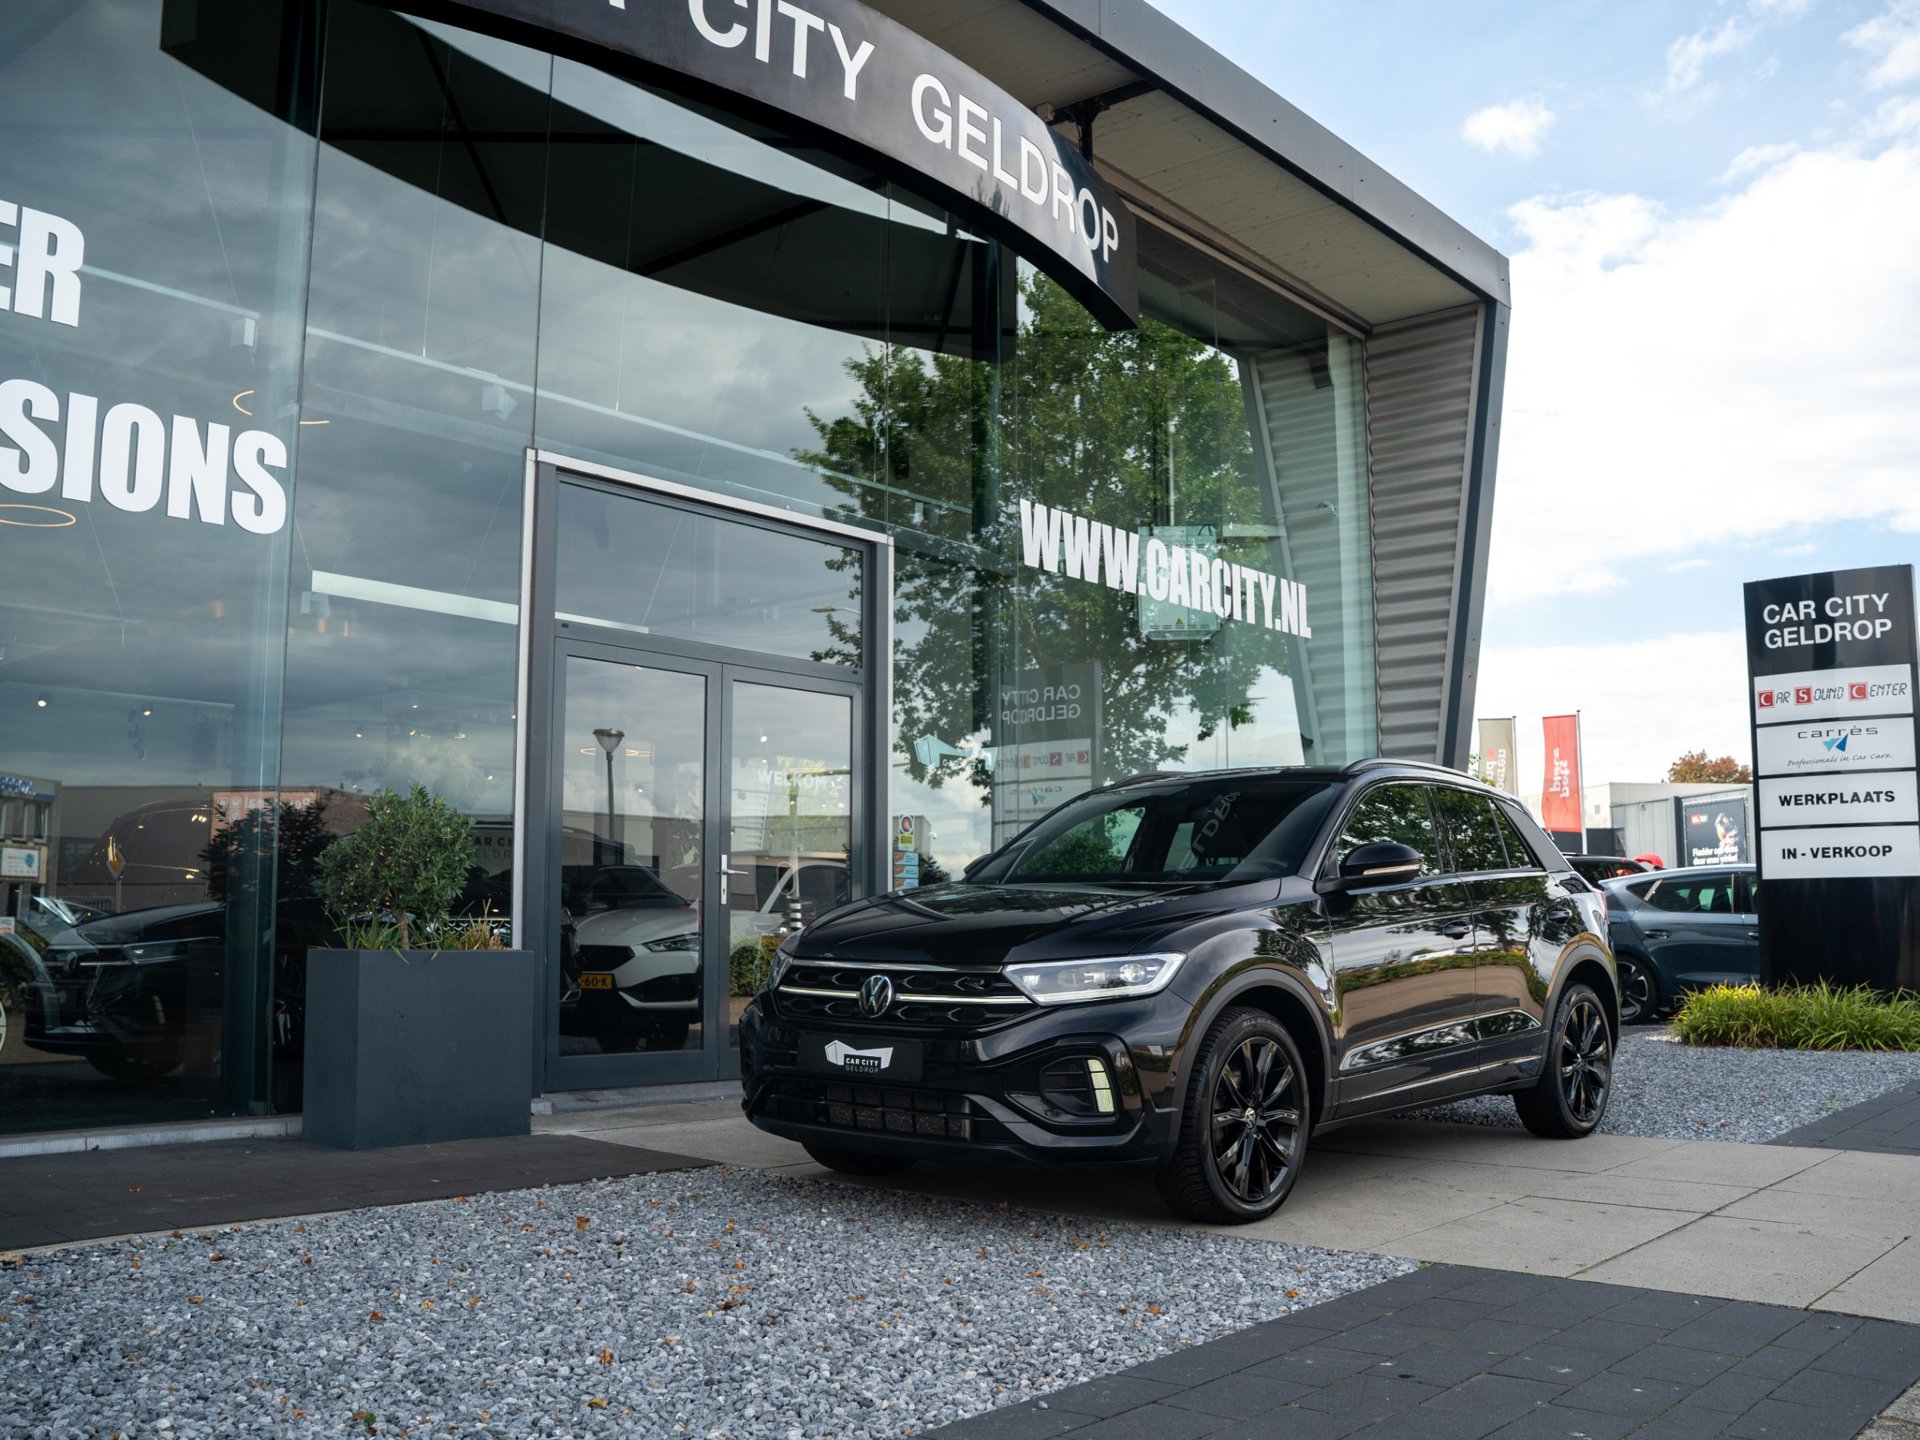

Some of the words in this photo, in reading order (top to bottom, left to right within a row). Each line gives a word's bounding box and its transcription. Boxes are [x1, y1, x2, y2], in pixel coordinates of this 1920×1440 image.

[688, 0, 875, 101] CITY
[911, 73, 1119, 264] GELDROP
[0, 379, 287, 534] SIONS
[1020, 498, 1312, 639] WWW.CARCITY.NL
[1763, 600, 1816, 624] CAR
[1824, 592, 1889, 617] CITY
[1764, 618, 1892, 649] GELDROP
[1779, 790, 1895, 806] WERKPLAATS
[1782, 848, 1797, 860] IN
[1810, 845, 1893, 859] VERKOOP
[845, 1057, 860, 1066] CAR
[861, 1059, 879, 1067] CITY
[845, 1064, 879, 1074] GELDROP
